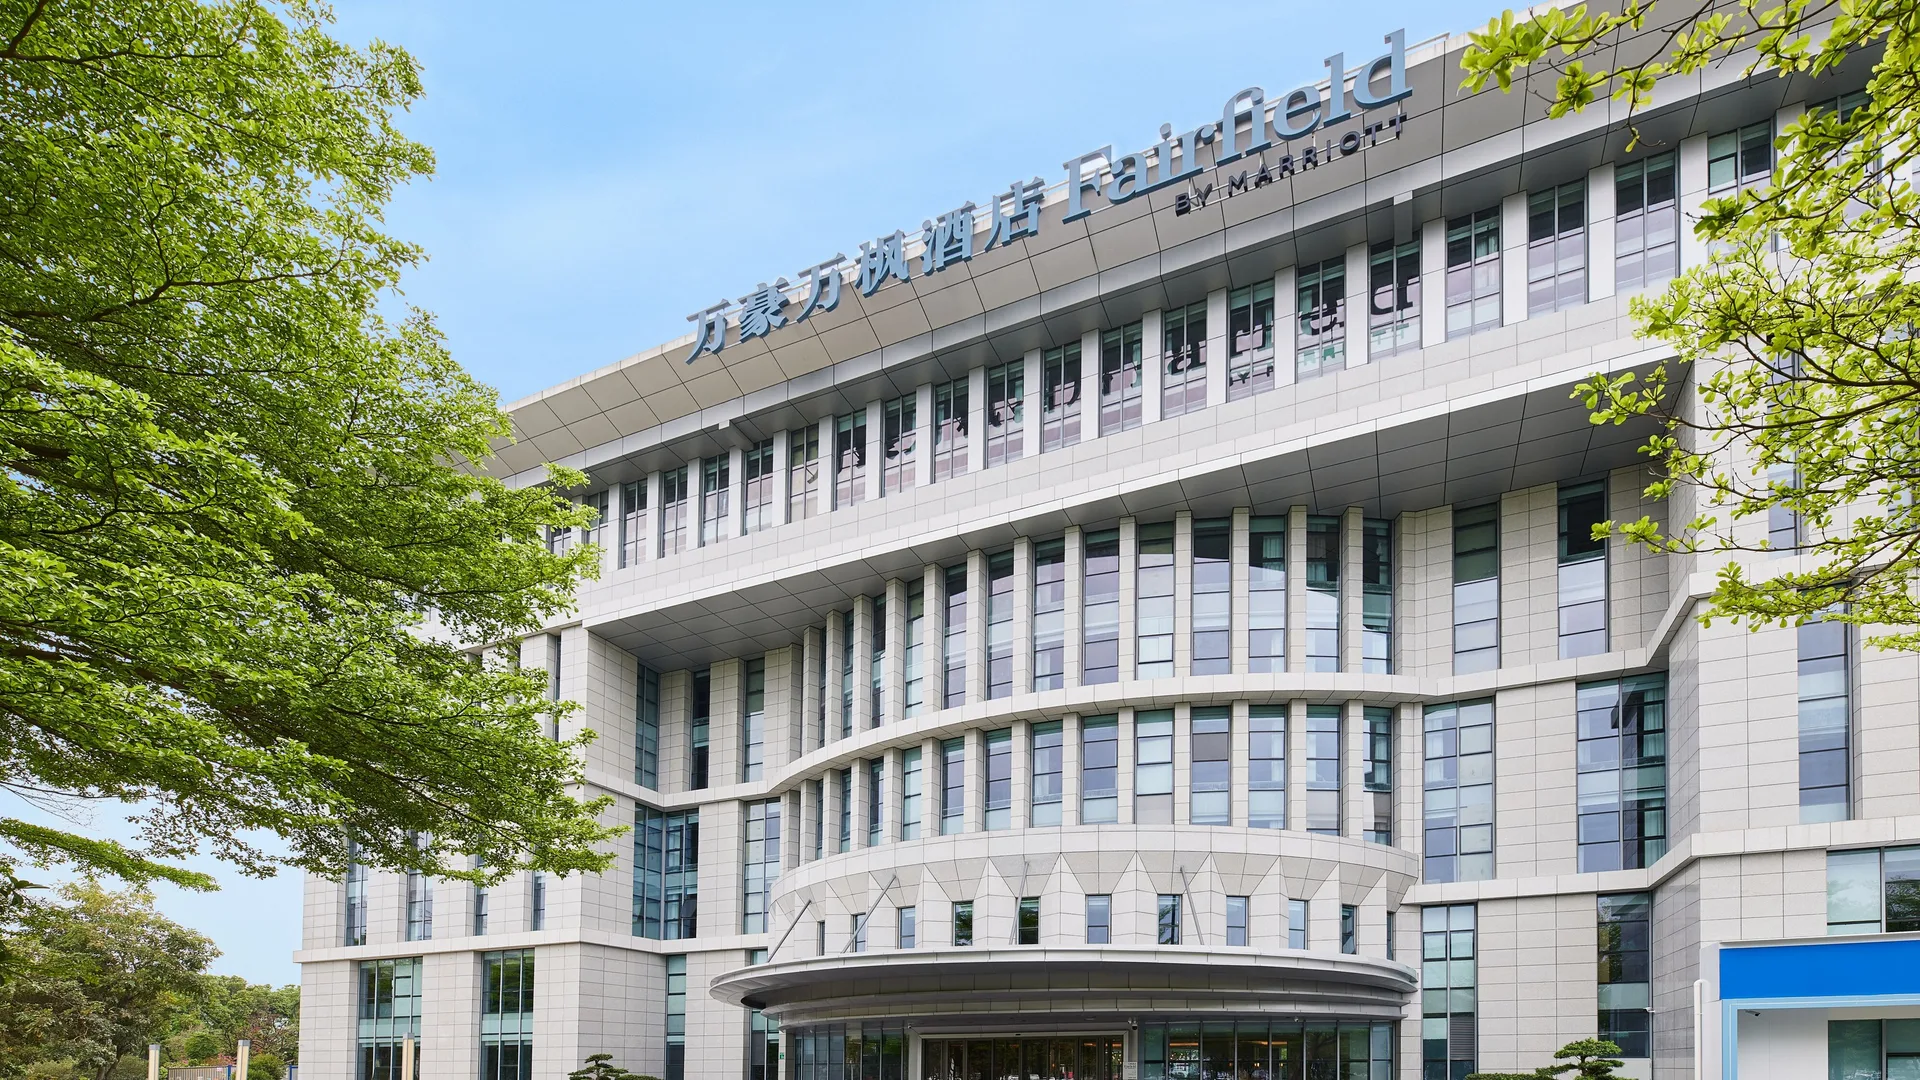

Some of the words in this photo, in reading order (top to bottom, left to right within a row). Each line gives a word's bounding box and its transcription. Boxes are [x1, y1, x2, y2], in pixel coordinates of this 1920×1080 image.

[1062, 28, 1413, 224] Fairfield
[1175, 183, 1213, 217] BY
[1228, 114, 1407, 197] MARRIOTT
[685, 176, 1045, 365] 万豪万枫酒店
